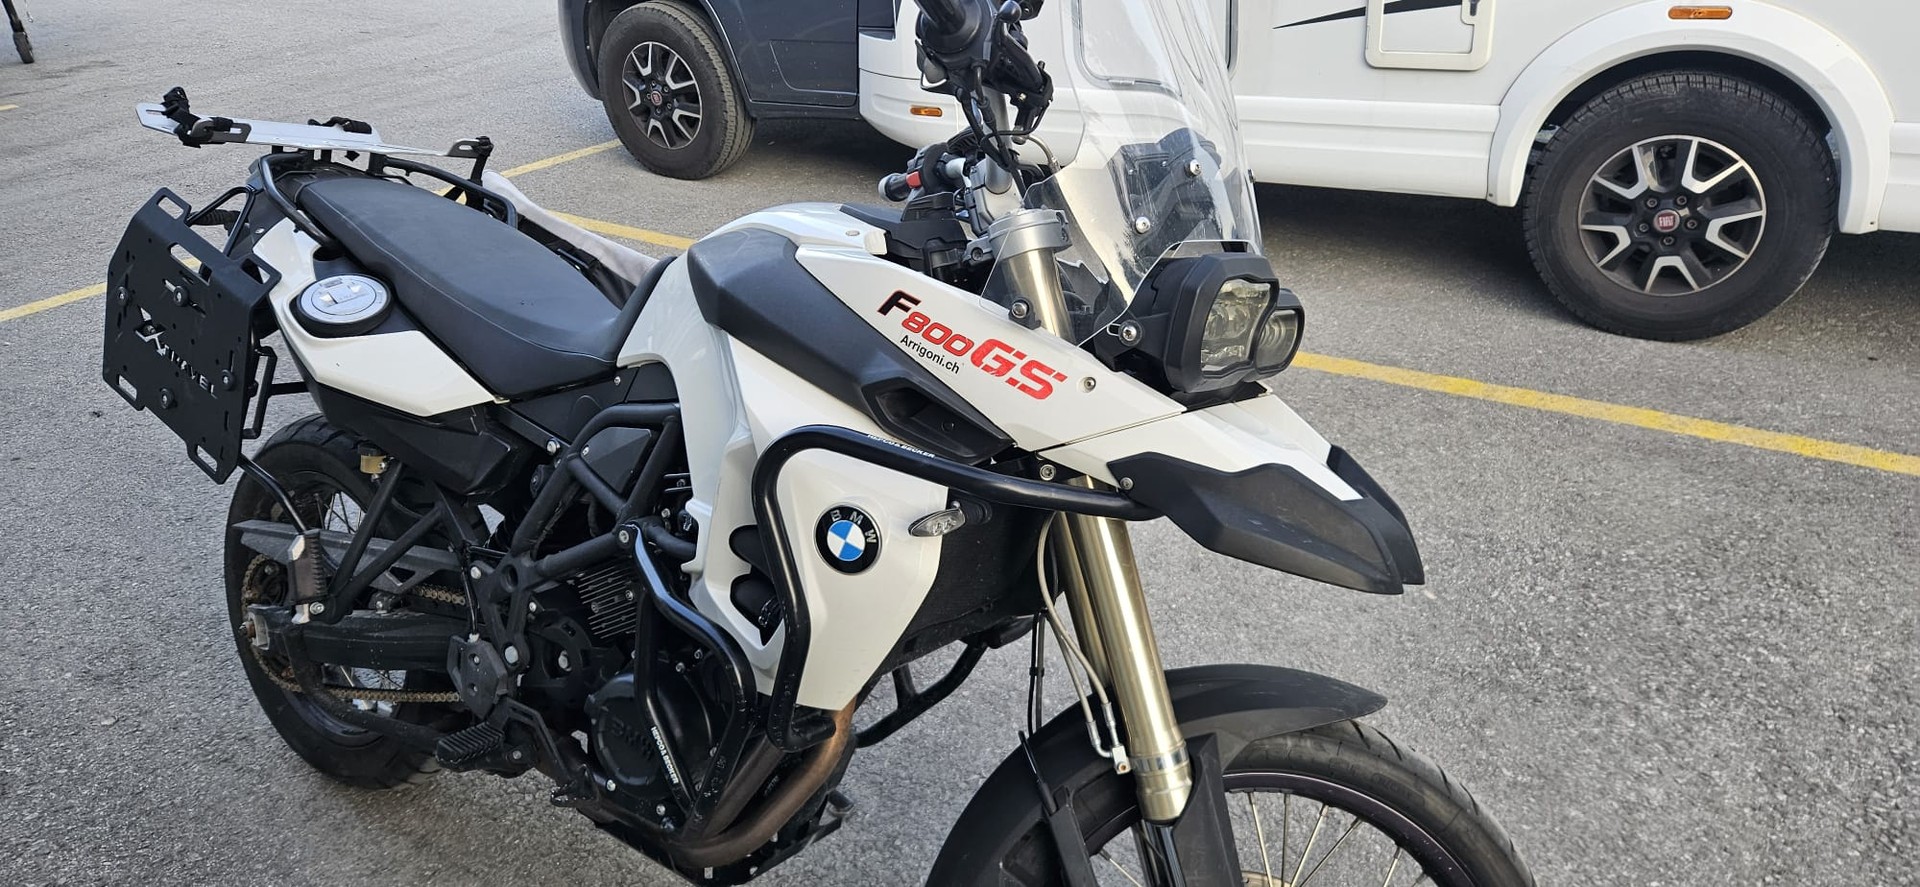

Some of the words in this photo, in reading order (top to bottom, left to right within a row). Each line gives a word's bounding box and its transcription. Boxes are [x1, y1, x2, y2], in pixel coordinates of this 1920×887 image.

[1658, 215, 1674, 227] FIAT
[900, 334, 960, 375] Arrigoni.ch
[830, 510, 877, 544] BMW
